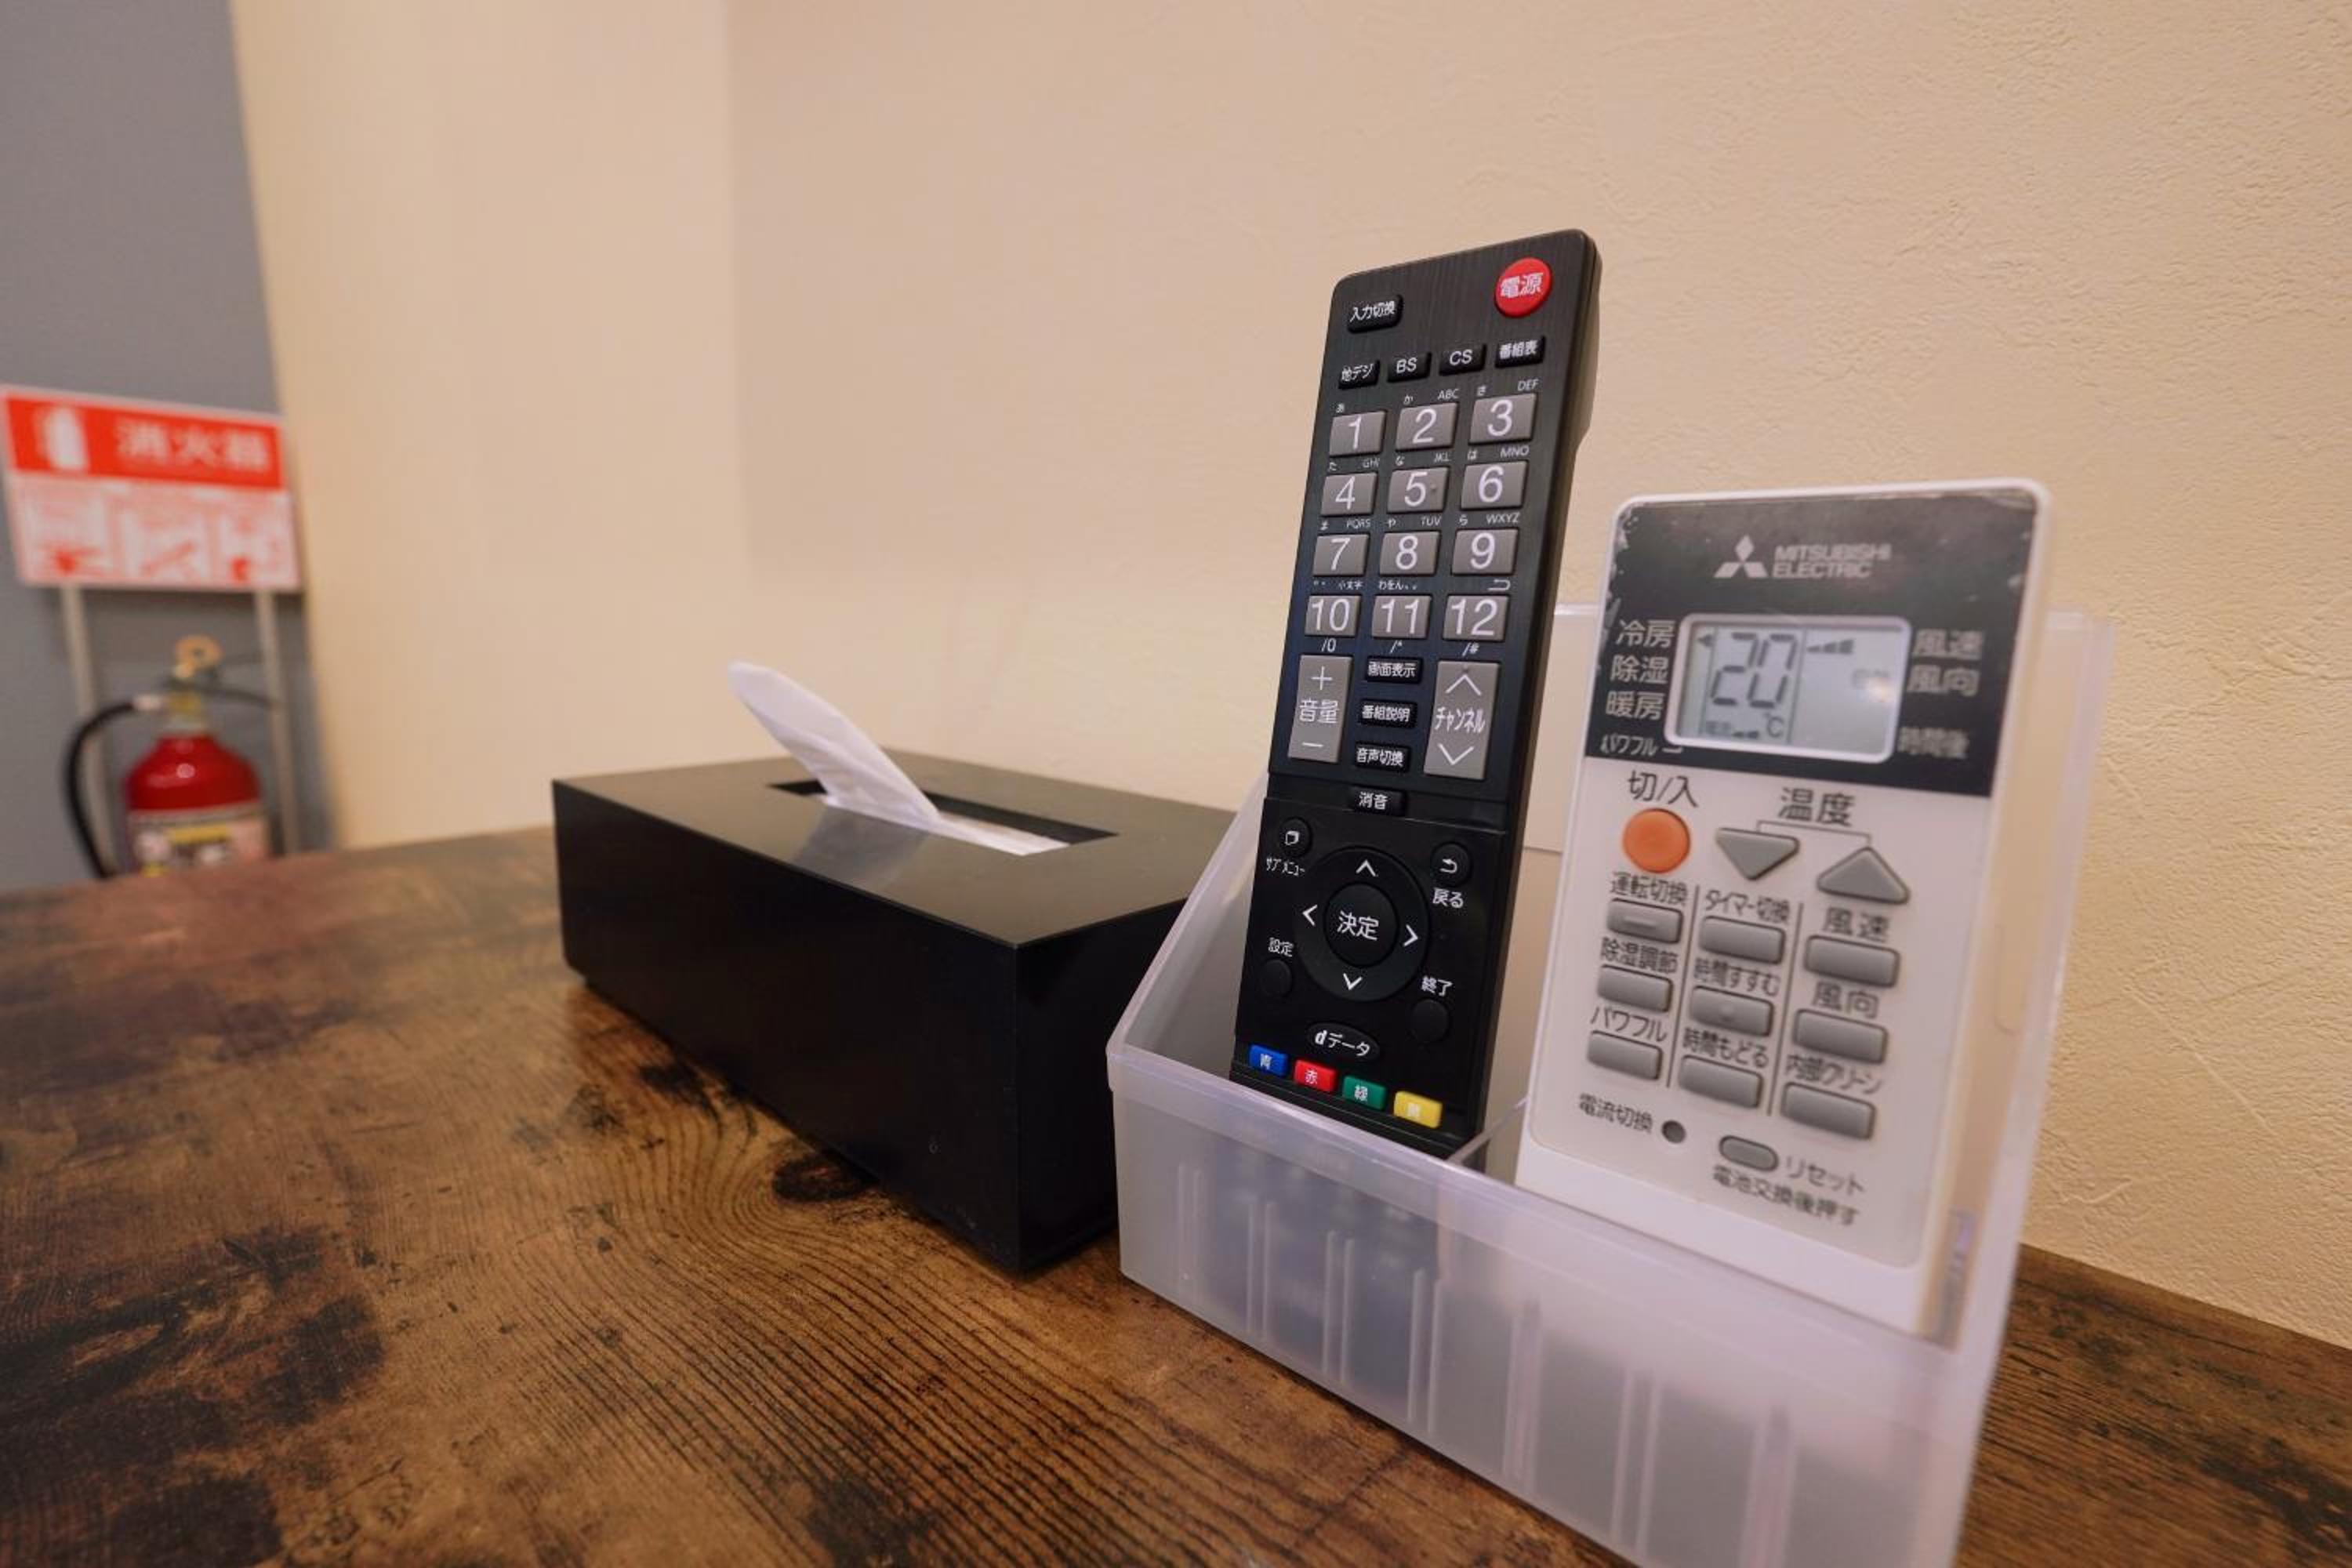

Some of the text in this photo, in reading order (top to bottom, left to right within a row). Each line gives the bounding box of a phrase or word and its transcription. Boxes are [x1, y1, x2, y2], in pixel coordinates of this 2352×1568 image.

[1501, 272, 1544, 298] 電源
[1349, 300, 1396, 322] 入力切換
[1450, 350, 1472, 365] CS
[1499, 339, 1539, 358] 番組表
[1341, 364, 1374, 382] 地デジ
[1396, 358, 1417, 374] BS
[1438, 388, 1460, 400] ABC
[1518, 379, 1539, 392] DEF
[1348, 414, 1362, 450] 1
[1412, 408, 1437, 444] 2
[1487, 399, 1513, 437] 3
[1500, 445, 1530, 458] MNO
[1335, 476, 1356, 510] 4
[1404, 471, 1428, 507] 5
[1478, 465, 1504, 503] 6
[1421, 516, 1442, 526] TUV
[1486, 512, 1520, 524] WXYZ
[1331, 537, 1351, 571] 7
[1396, 535, 1419, 570] 8
[1470, 532, 1496, 570] 9
[1773, 543, 1891, 561] MITSUBISHI
[1772, 561, 1872, 579] ELECTRIC
[1312, 599, 1351, 631] 10
[1381, 598, 1420, 634] 11
[1451, 598, 1498, 636] 12
[1617, 619, 1676, 648] 冷房
[1368, 661, 1416, 678] 画面表示
[1610, 655, 1669, 684] 除湿
[1710, 632, 1798, 709] 20
[1298, 699, 1340, 724] 音量
[1362, 705, 1410, 722] 番組説明
[1434, 706, 1486, 733] チャンネル
[1605, 691, 1665, 720] 暖房
[1356, 746, 1404, 767] 音声切換
[1359, 791, 1388, 810] 消音
[1628, 770, 1698, 808] 切/入
[1777, 786, 1855, 827] 温度
[1432, 887, 1465, 909] 戻る
[1610, 871, 1689, 906] 運転切換
[1337, 910, 1380, 941] 決定
[1822, 907, 1891, 942] 風速
[1268, 937, 1294, 957] 設定
[1600, 936, 1679, 975] 除湿調節
[1421, 975, 1453, 996] 終了
[1812, 982, 1879, 1018] 風向
[1590, 1007, 1668, 1043] パワフル
[1315, 1030, 1370, 1057] dデータ
[1682, 1027, 1769, 1069] 時間もどる
[1305, 1069, 1318, 1085] 赤
[1578, 1094, 1653, 1134] 電流切換
[1787, 1154, 1866, 1194] リセット
